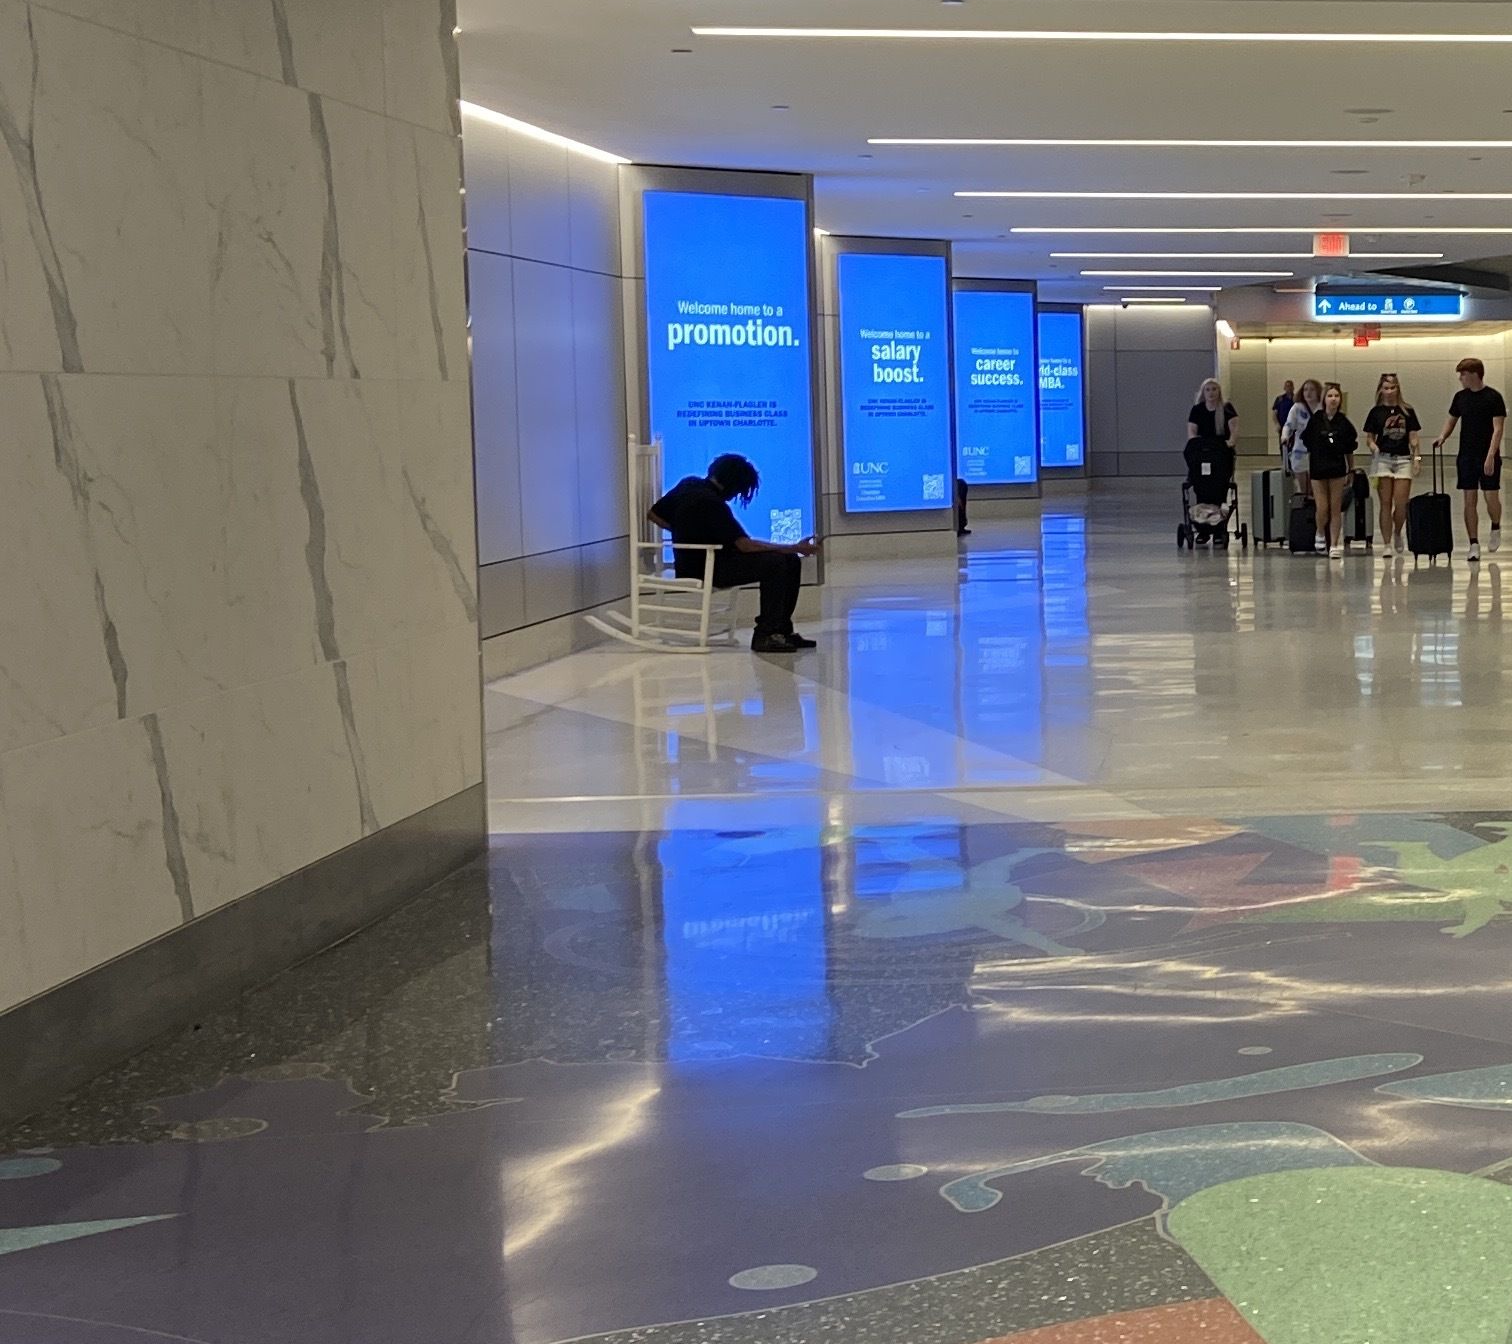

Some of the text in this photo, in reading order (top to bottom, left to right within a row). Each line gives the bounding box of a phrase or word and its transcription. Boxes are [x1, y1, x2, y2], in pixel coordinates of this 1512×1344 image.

[677, 300, 783, 317] Welcome home to a
[1338, 301, 1378, 311] Ahead to
[667, 318, 800, 351] promotion.
[915, 330, 924, 340] to
[871, 340, 921, 364] salary
[975, 358, 1016, 371] career
[873, 362, 924, 383] boost.
[970, 372, 1024, 386] success.
[861, 462, 889, 474] UNC
